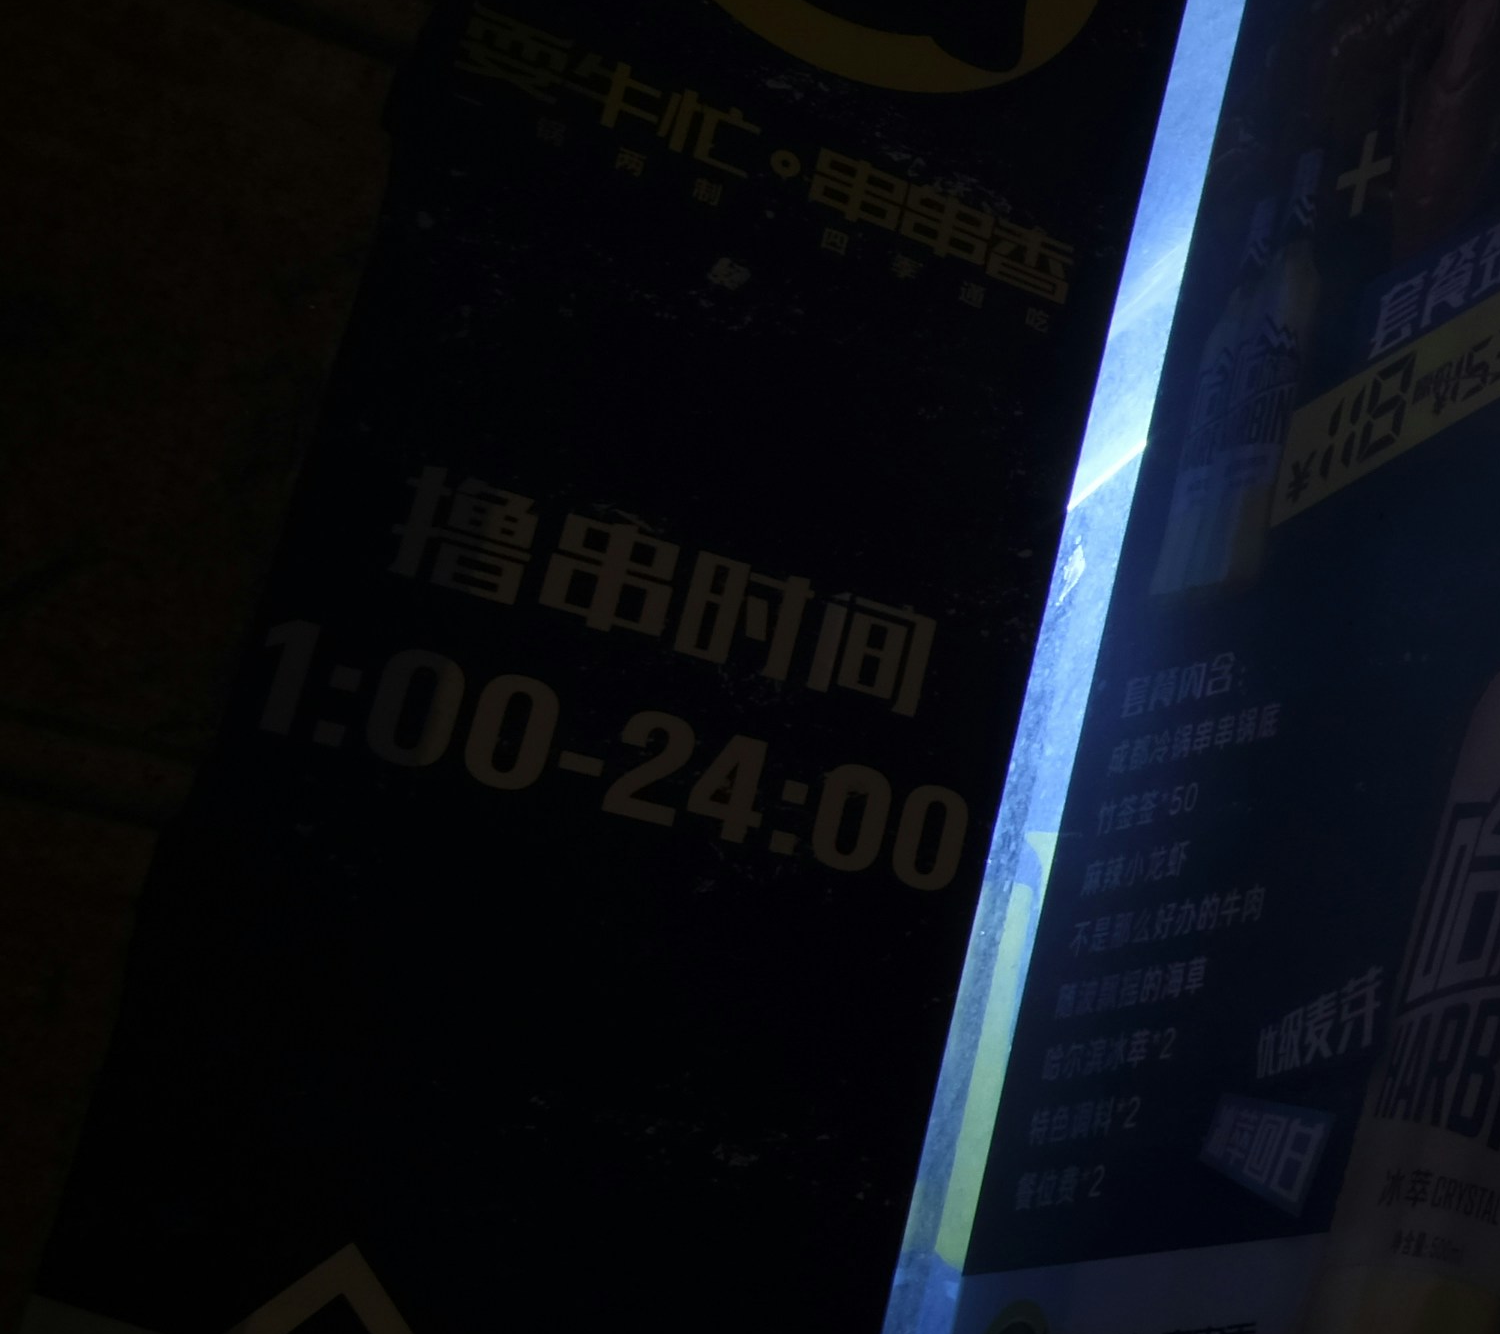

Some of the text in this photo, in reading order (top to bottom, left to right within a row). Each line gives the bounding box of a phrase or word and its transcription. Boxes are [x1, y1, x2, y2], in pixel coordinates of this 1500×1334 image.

[387, 465, 938, 718] 撸串时间
[1432, 1175, 1500, 1227] CRYSTAL
